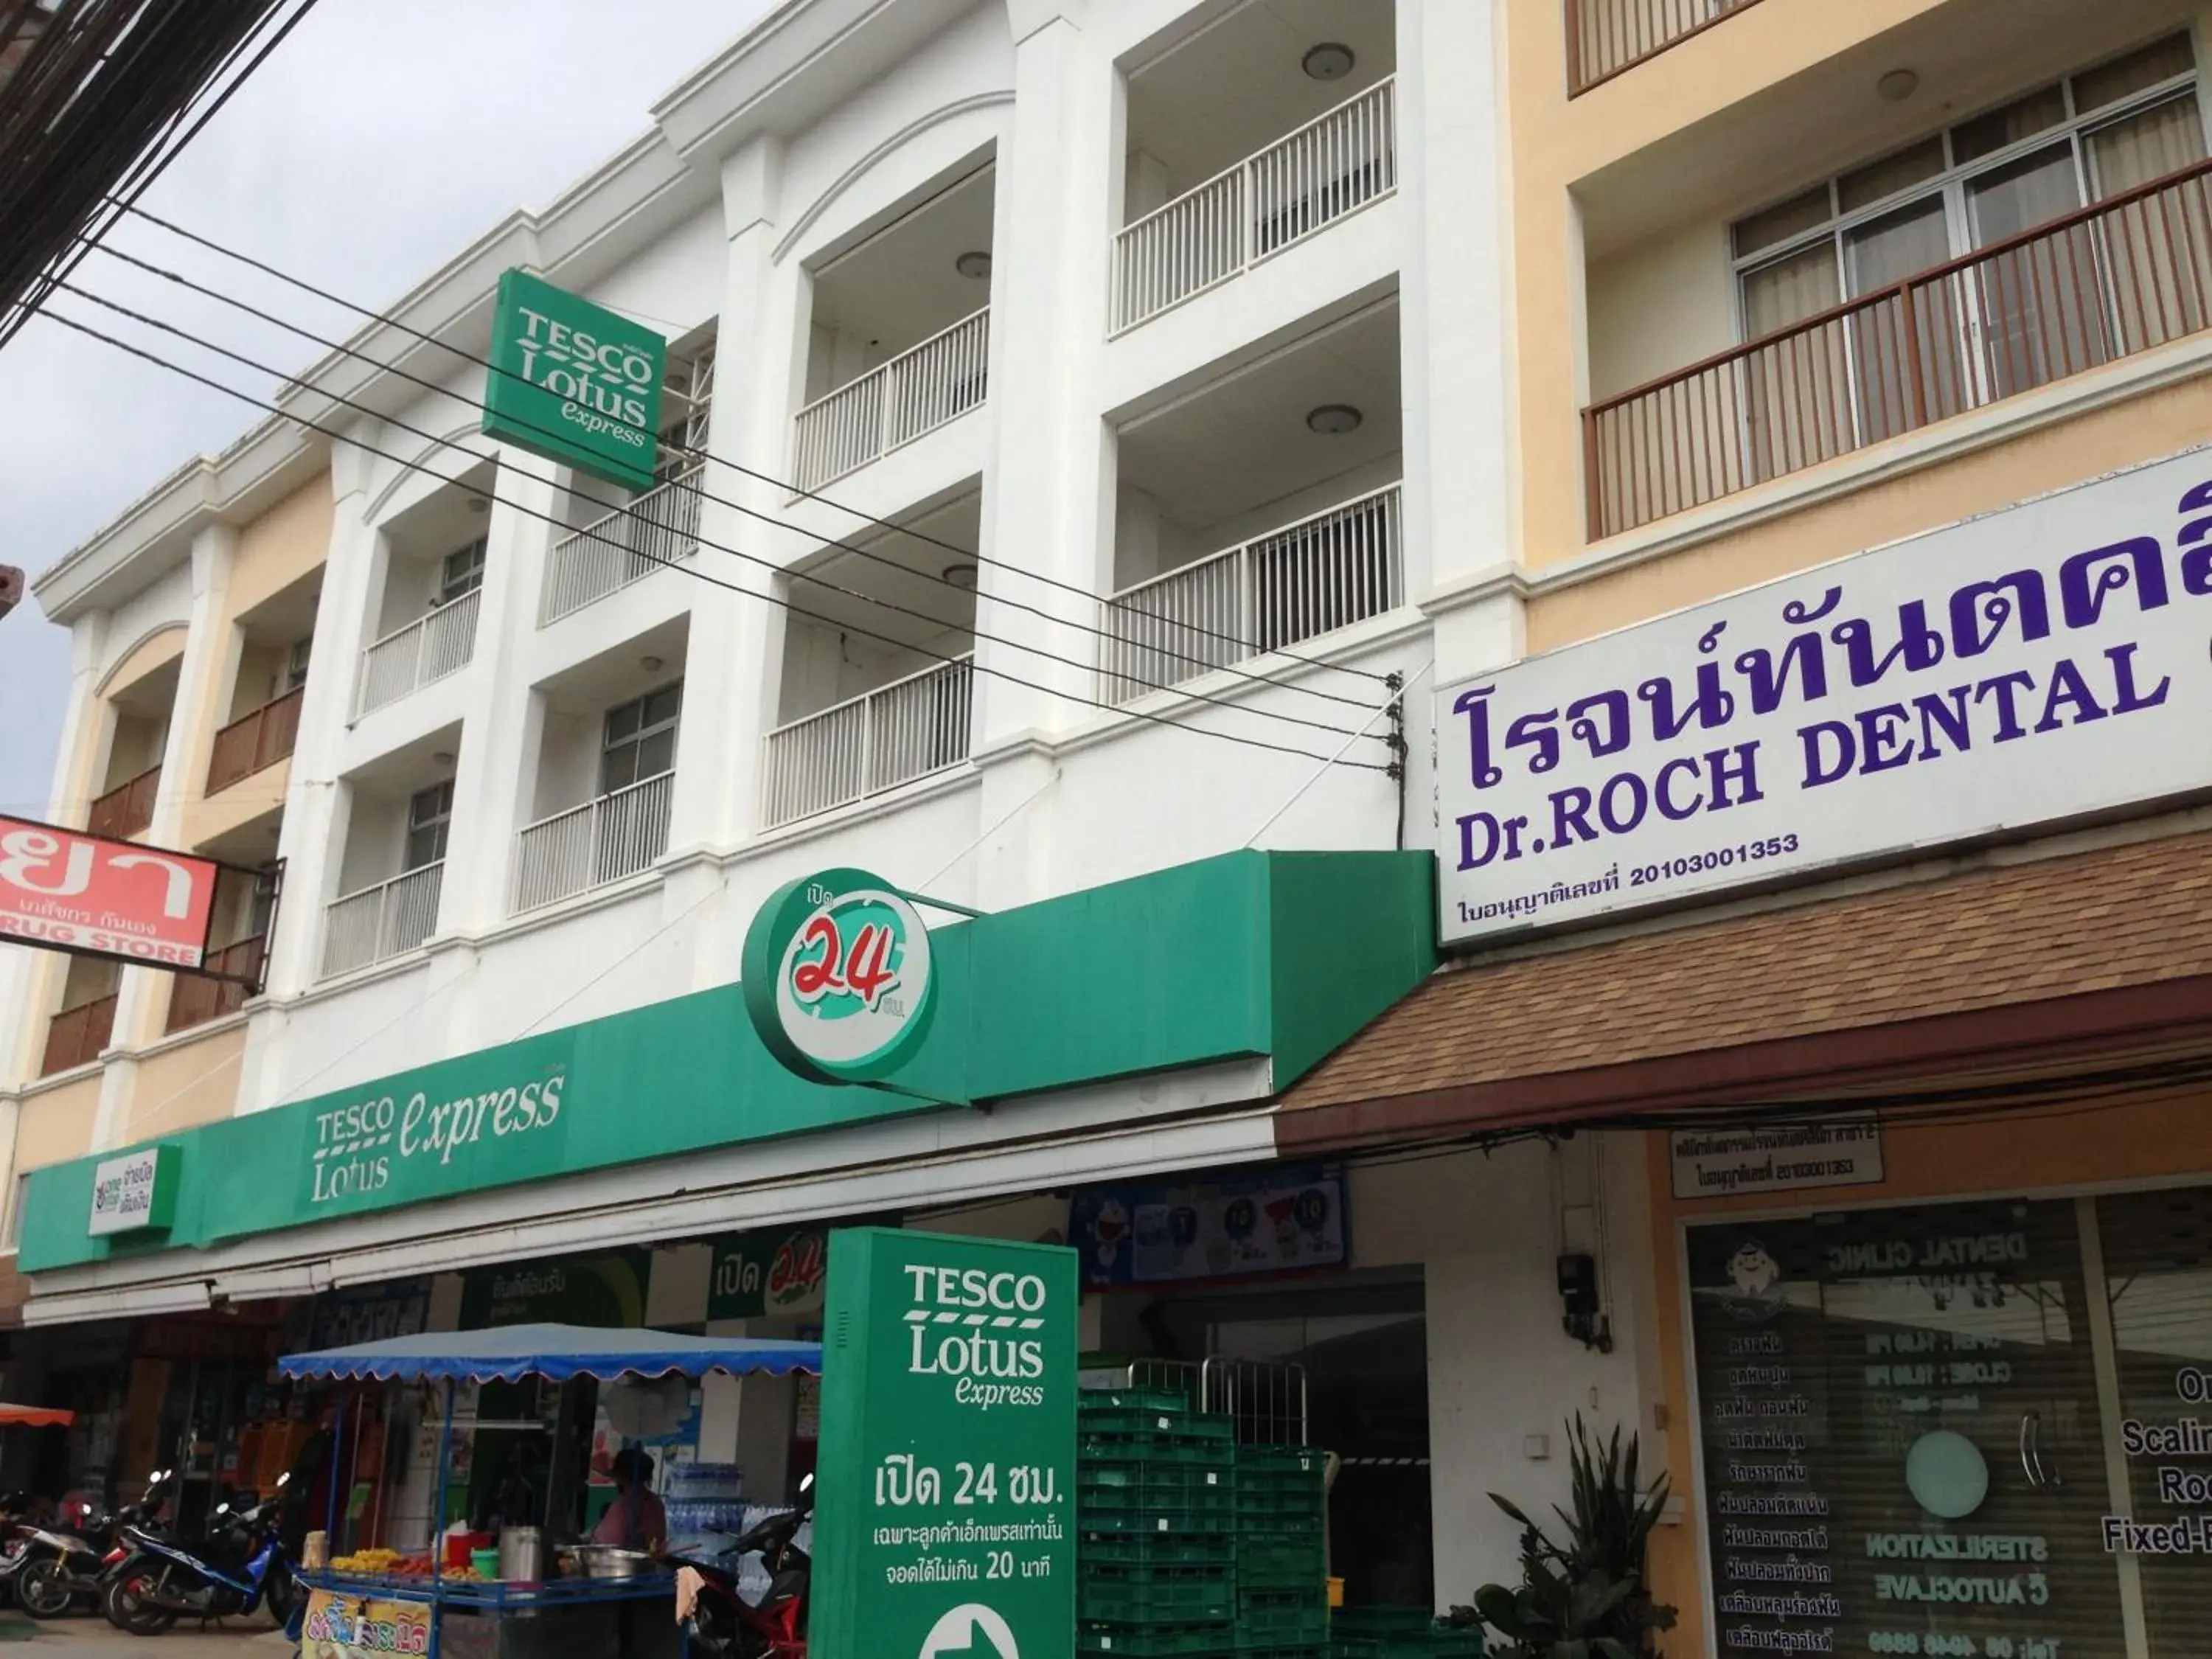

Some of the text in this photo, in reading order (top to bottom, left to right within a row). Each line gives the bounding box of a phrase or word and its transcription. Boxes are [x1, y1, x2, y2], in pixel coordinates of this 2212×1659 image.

[519, 307, 653, 384] TESCO
[522, 348, 647, 428] Lotus
[561, 401, 646, 448] express
[1799, 642, 2172, 789] DENTAL
[0, 830, 192, 919] ยา
[1630, 833, 1799, 886] 20103001353
[89, 932, 196, 966] STORE
[794, 915, 894, 1003] 24
[316, 1096, 396, 1144] TESCO
[400, 1074, 565, 1164] express
[311, 1152, 390, 1203] Lotus
[716, 1253, 760, 1296] เปิด
[904, 1264, 1046, 1312] TESCO
[908, 1325, 1043, 1379] Lotus
[954, 1377, 1043, 1411] express
[874, 1454, 1064, 1506] เปิด 24 ชม.
[887, 1551, 1051, 1583] จอดได้ไม่เกิน 20 นาที
